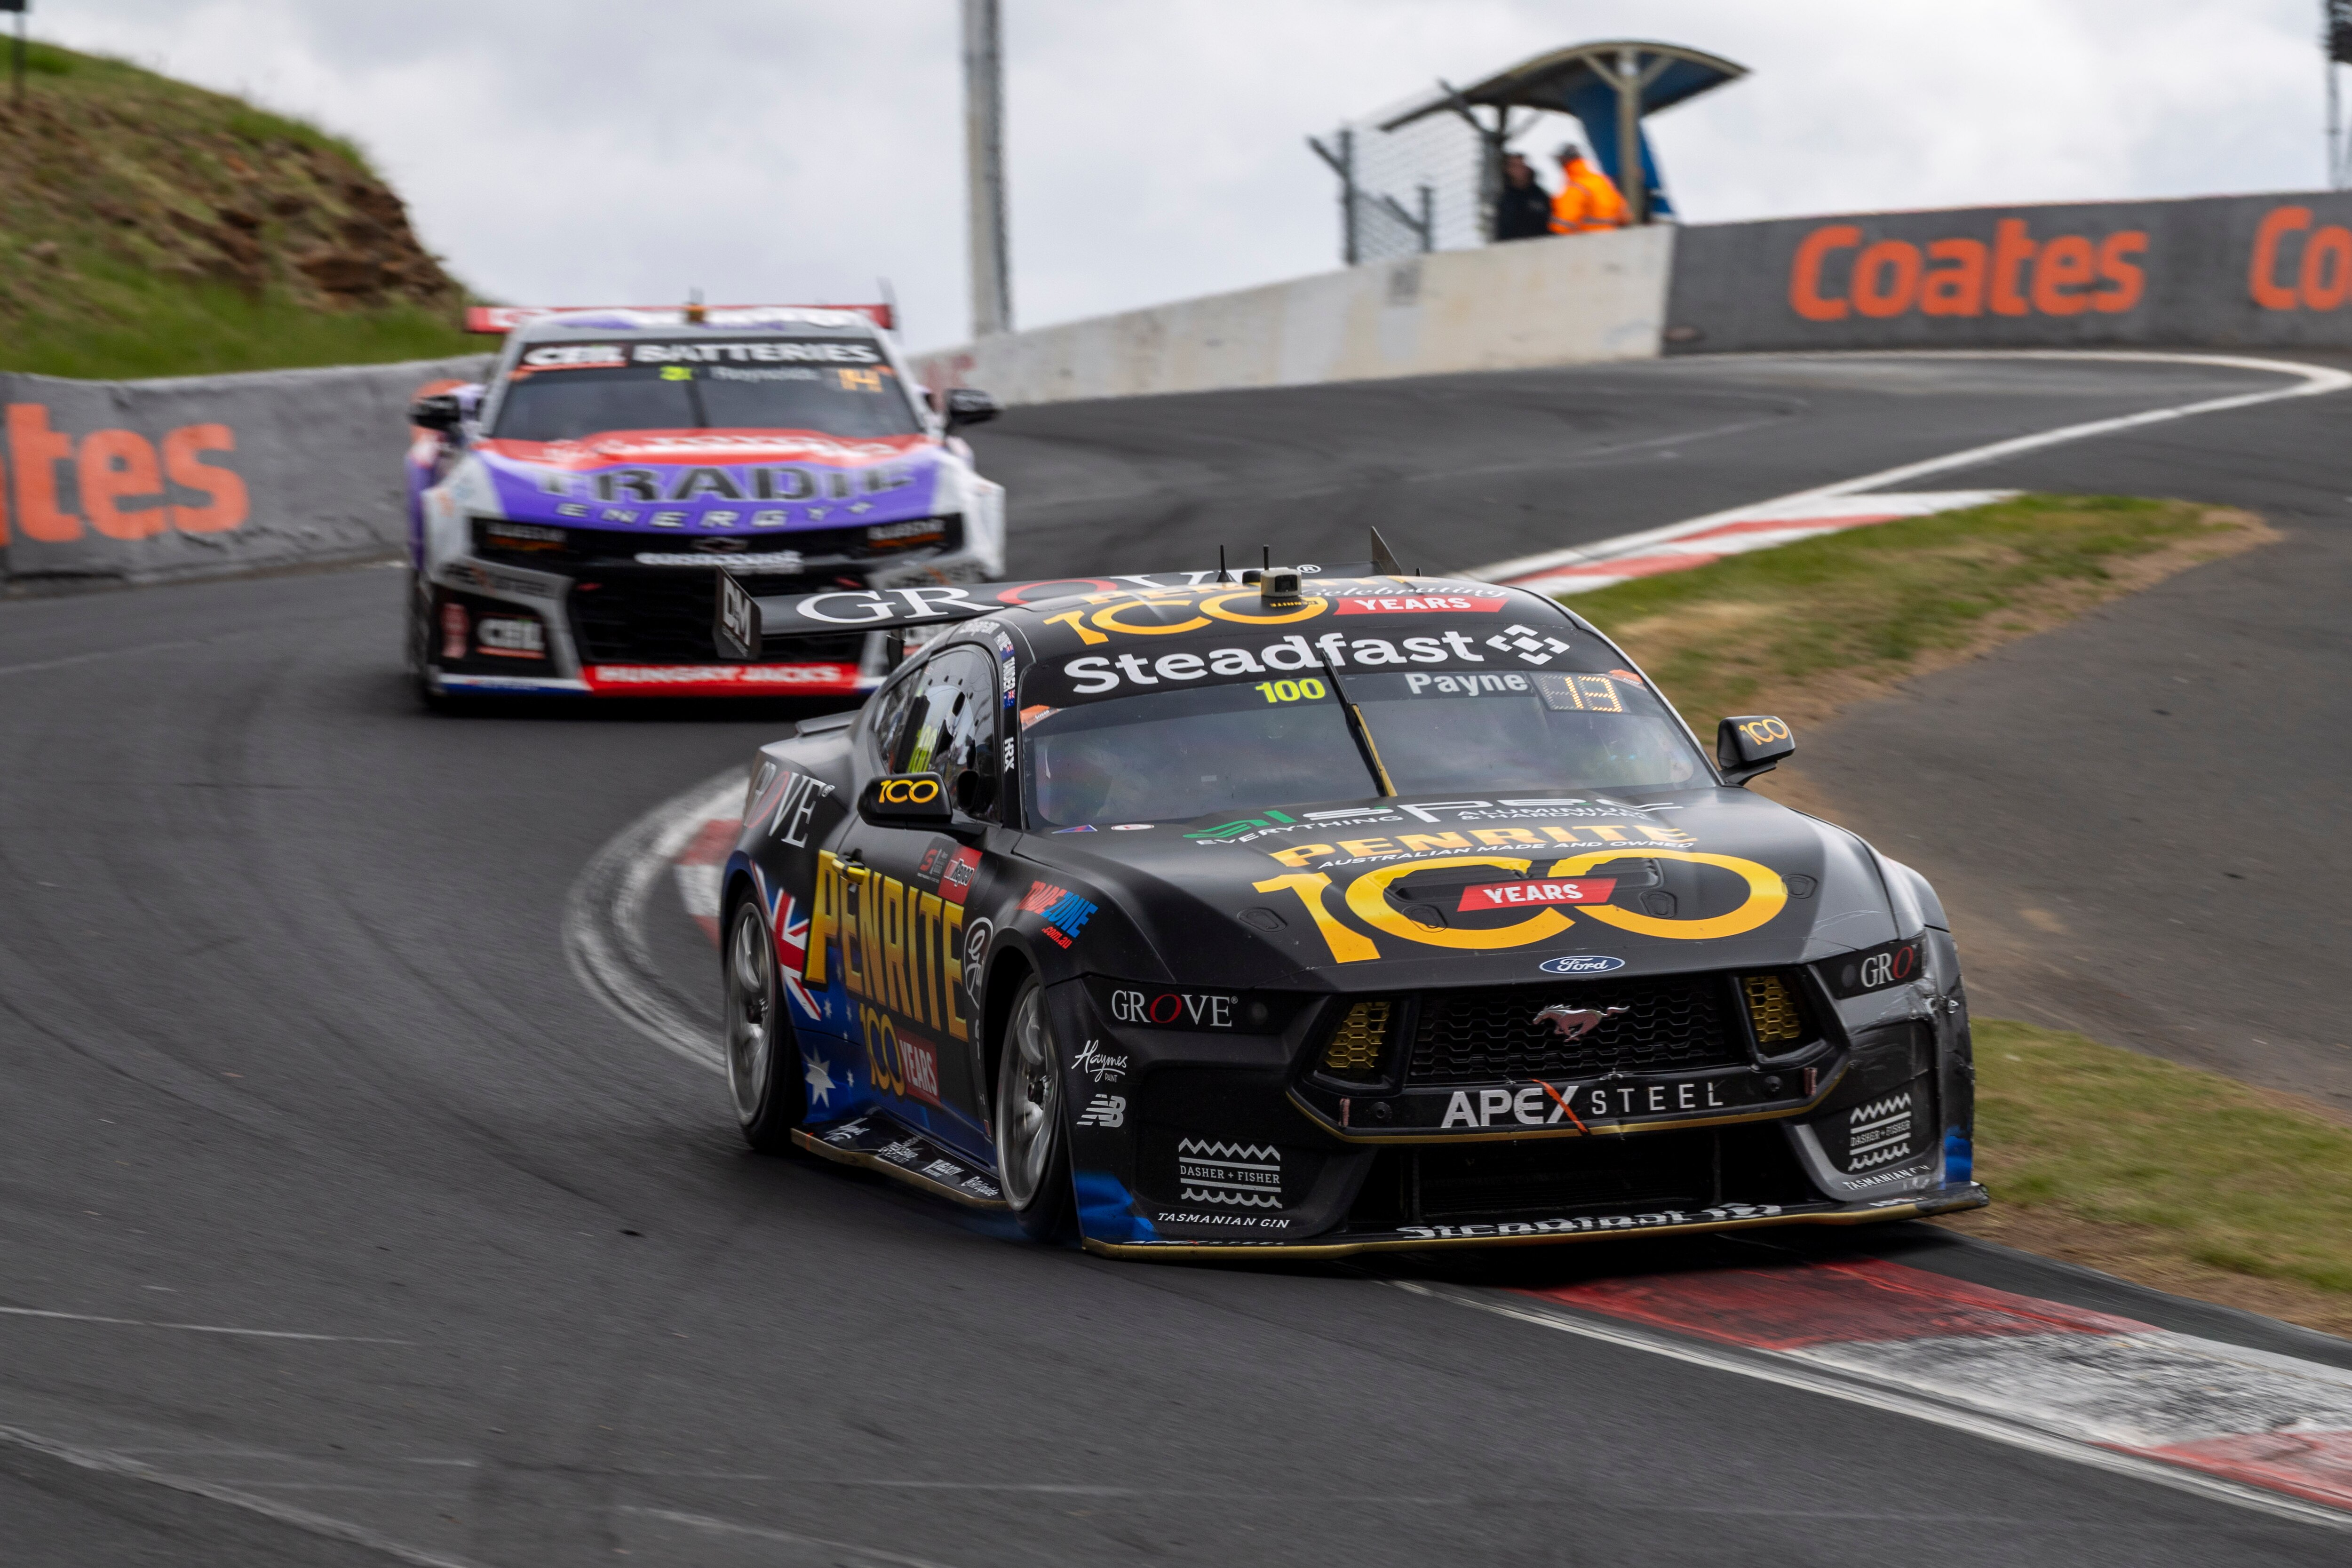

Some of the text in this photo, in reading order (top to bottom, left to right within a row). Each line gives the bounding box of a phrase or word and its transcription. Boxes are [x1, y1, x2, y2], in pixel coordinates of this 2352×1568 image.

[1789, 217, 2150, 322] Coates
[2248, 205, 2352, 312] Co
[633, 343, 880, 363] BATTERIES
[0, 403, 250, 547] tes
[555, 501, 838, 529] ENERGY
[1354, 597, 1471, 611] YEARS
[1064, 630, 1485, 693] Steadfast
[1255, 678, 1326, 703] 100
[1405, 672, 1529, 696] Payne
[1565, 676, 1623, 713] 13
[1004, 737, 1015, 773] HRX
[1195, 815, 1404, 845] EVERYTHING
[1269, 824, 1698, 867] PENRITE
[1317, 846, 1470, 869] AUSTRALIAN
[1476, 843, 1547, 852] MADE
[1483, 884, 1583, 904] YEARS
[1016, 880, 1099, 939] TRADEZONE
[805, 849, 969, 1043] PENRITE
[1041, 926, 1073, 949] .com.au
[1555, 956, 1608, 971] Ford
[1861, 946, 1915, 987] GRO
[899, 1039, 938, 1096] YEARS
[1071, 1039, 1128, 1082] Haymes
[1105, 1073, 1118, 1083] PAINT
[1440, 1079, 1724, 1132] APEX STEEL
[1850, 1130, 1881, 1147] DASHER
[1885, 1120, 1911, 1136] FISHER
[1180, 1164, 1224, 1179] DASHER
[1238, 1171, 1280, 1184] FISHER
[1843, 1170, 1914, 1191] TASMANIAN
[1157, 1212, 1290, 1229] TASMANIAN GIN
[1395, 1210, 1692, 1239] Steadfast
